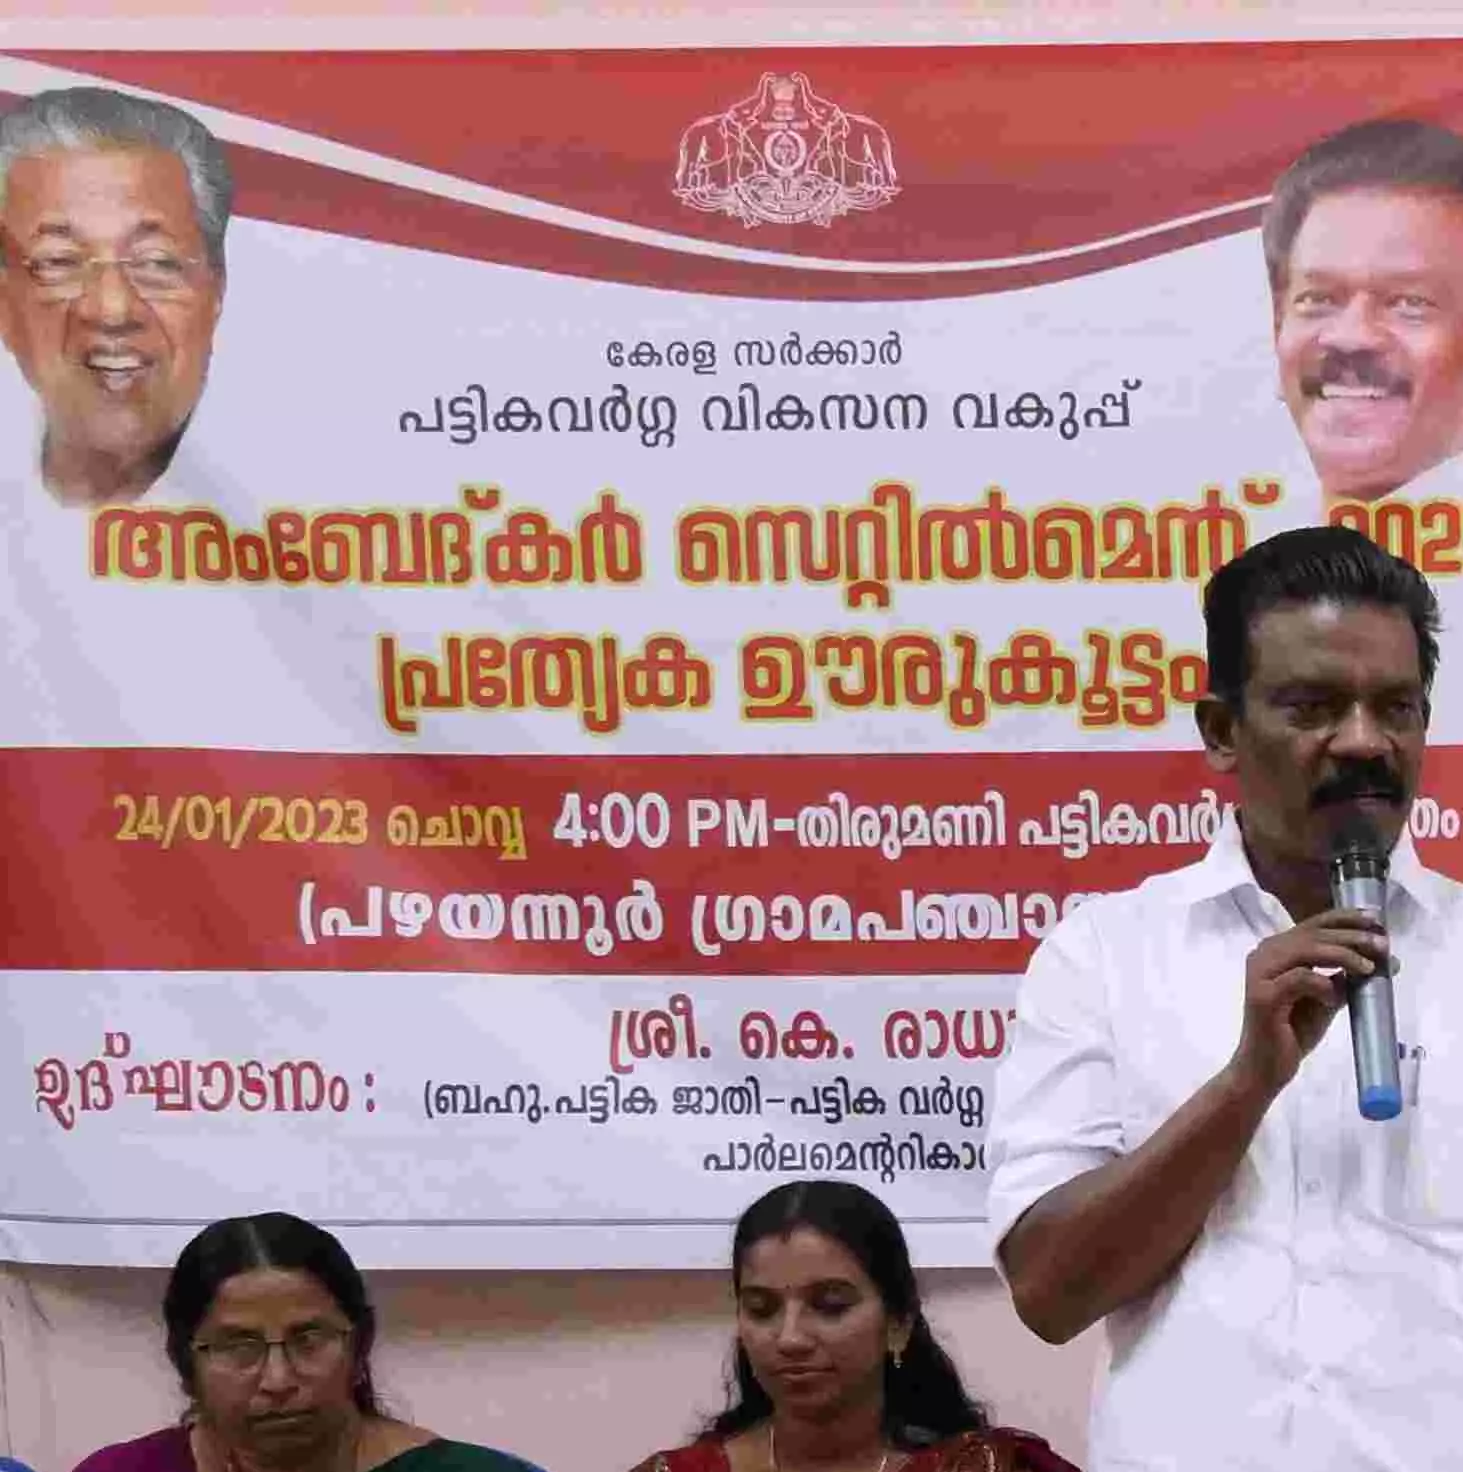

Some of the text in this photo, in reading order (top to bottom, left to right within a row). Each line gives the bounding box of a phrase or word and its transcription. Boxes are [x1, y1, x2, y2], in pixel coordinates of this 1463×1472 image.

[606, 331, 902, 375] കേരള സർക്കാർ
[399, 377, 1143, 448] പട്ടികവർഗ്ഗ വികസന വകുപ്പ്
[89, 485, 643, 585] അംബേദ്കർ
[377, 632, 1208, 734] പ്രത്യേക ഊരുകൂട്ടം
[113, 795, 369, 849] 24/01/2023
[387, 804, 526, 861] ചൊവ്വ
[553, 791, 671, 849] 4:00
[1018, 789, 1237, 858] പട്ടികവർ
[609, 992, 712, 1074] ശ്രീ.
[739, 1010, 855, 1060] കെ.
[899, 1075, 984, 1128] വർഗ്ഗ
